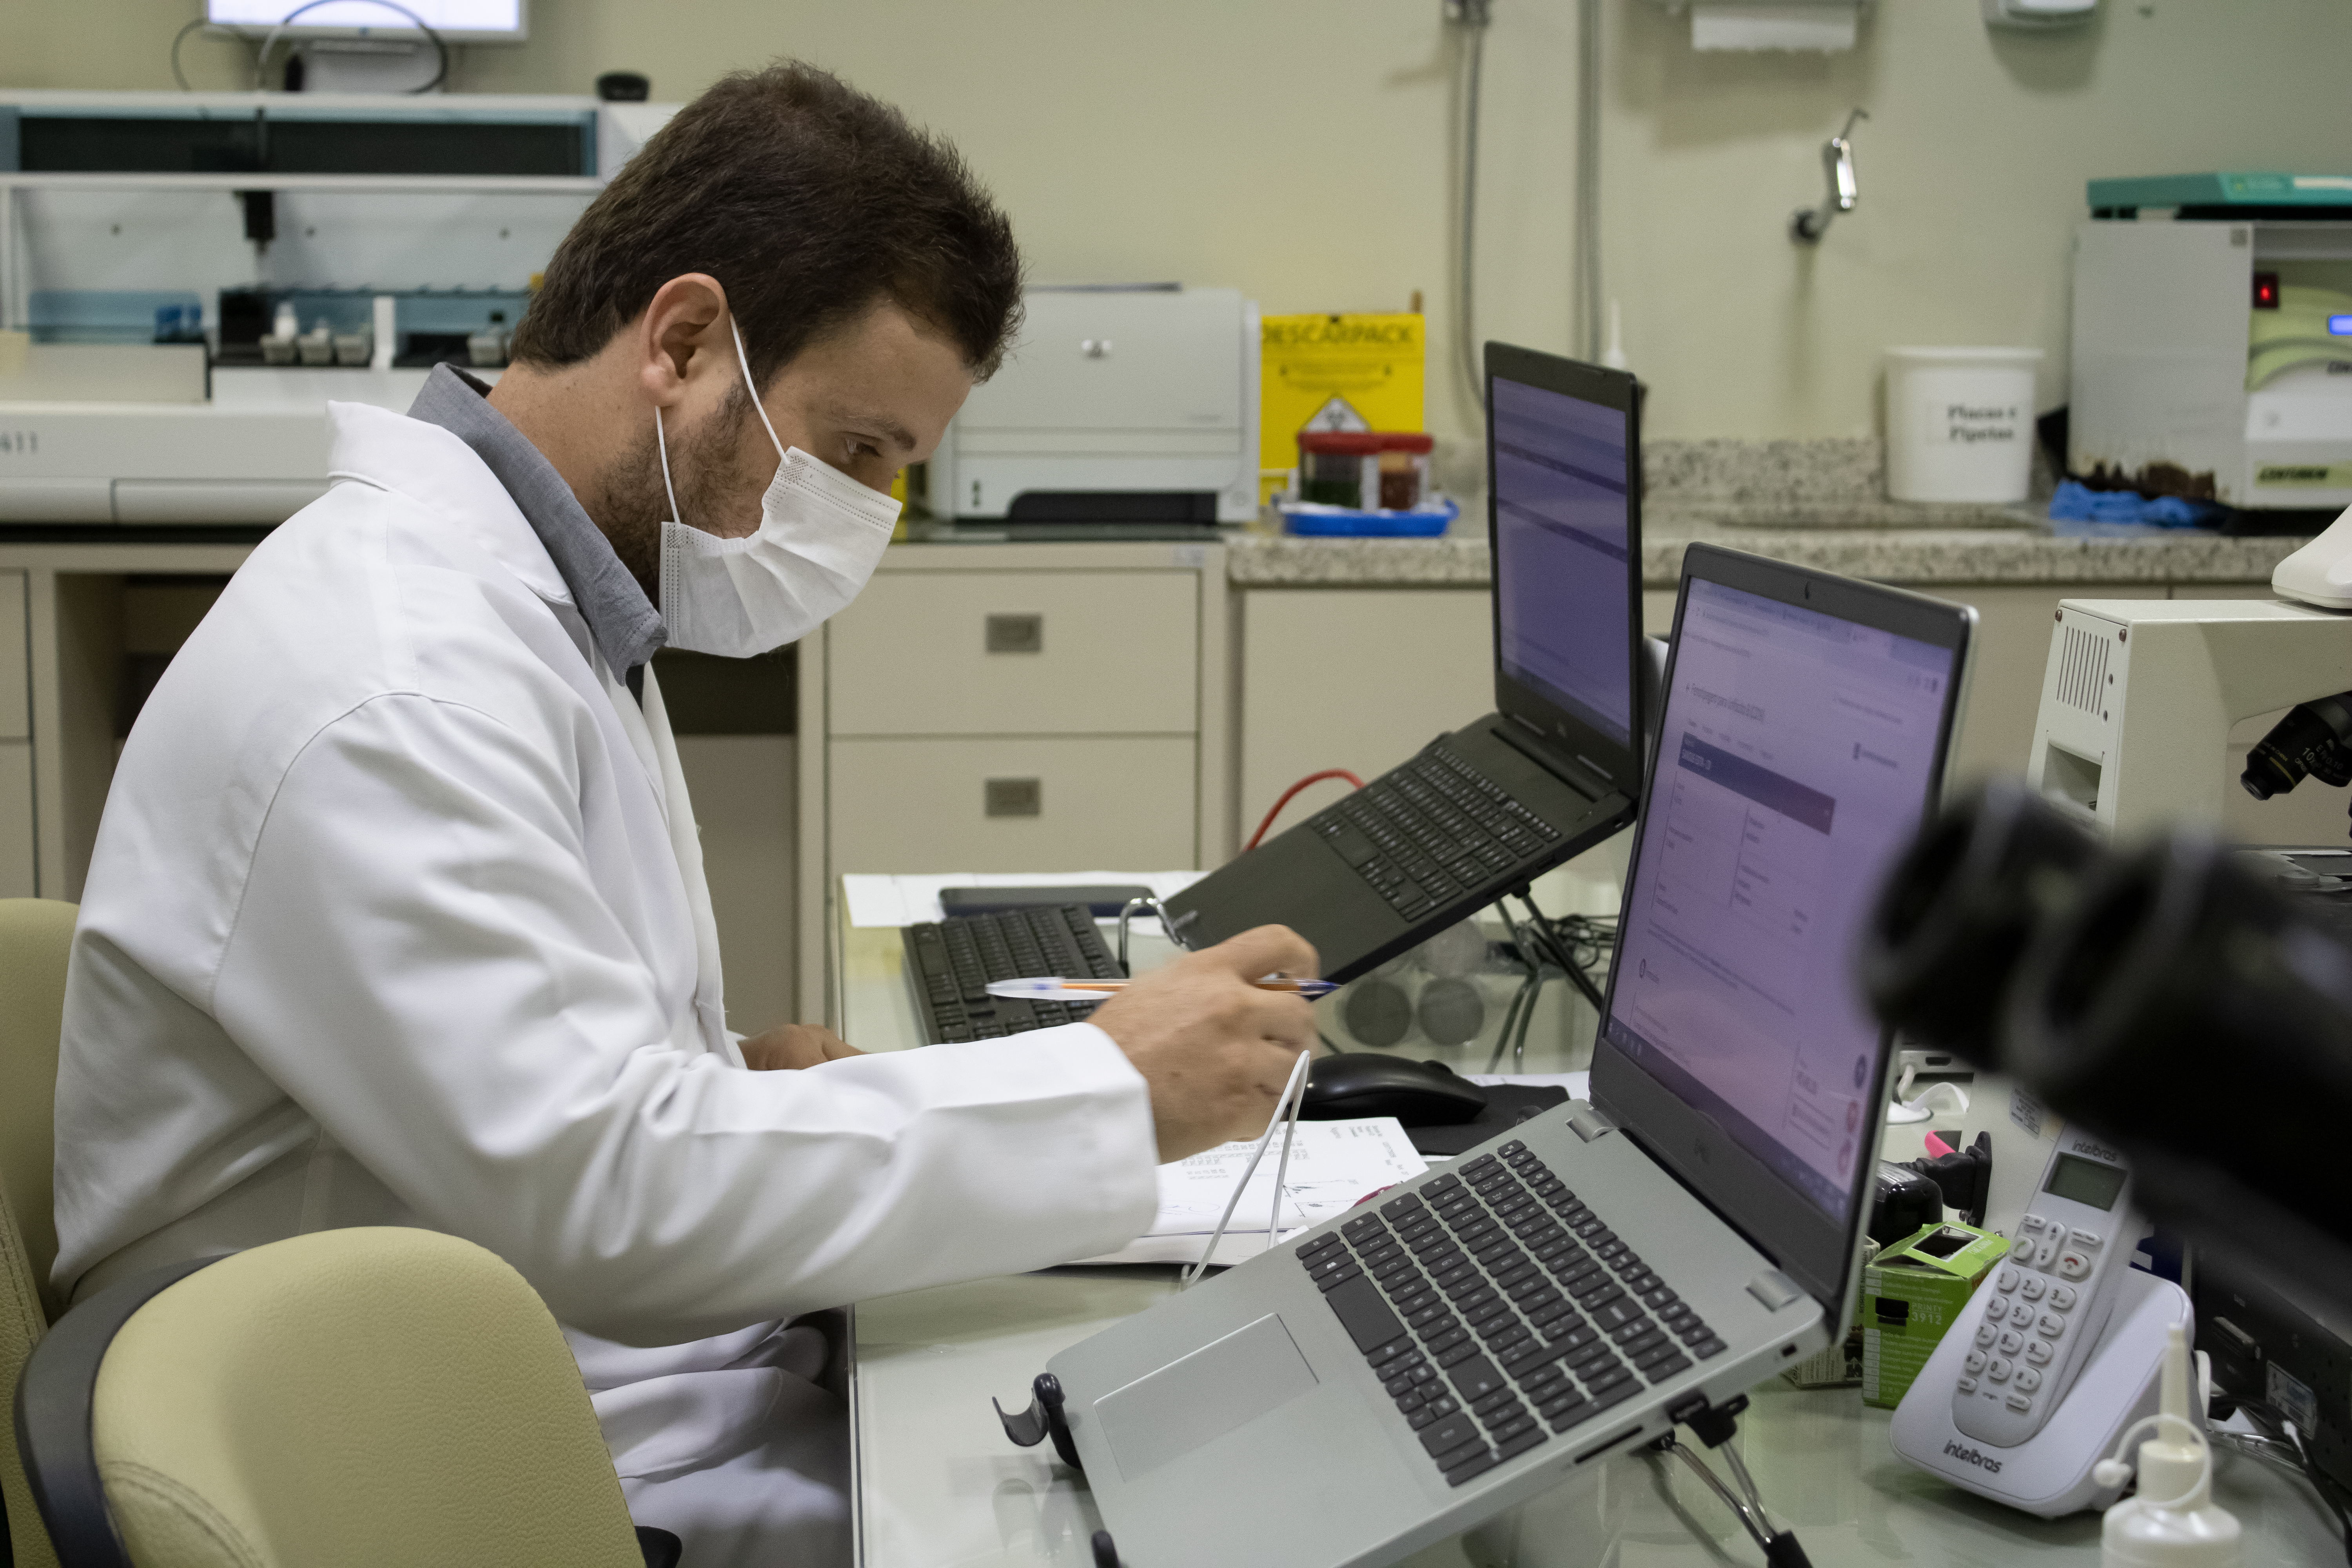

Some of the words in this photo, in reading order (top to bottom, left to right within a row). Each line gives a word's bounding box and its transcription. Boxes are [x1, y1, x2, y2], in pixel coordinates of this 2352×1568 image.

[1912, 1302, 1942, 1312] PRINTY
[1911, 1312, 1942, 1325] 3912
[1942, 1439, 2003, 1474] intelbras
